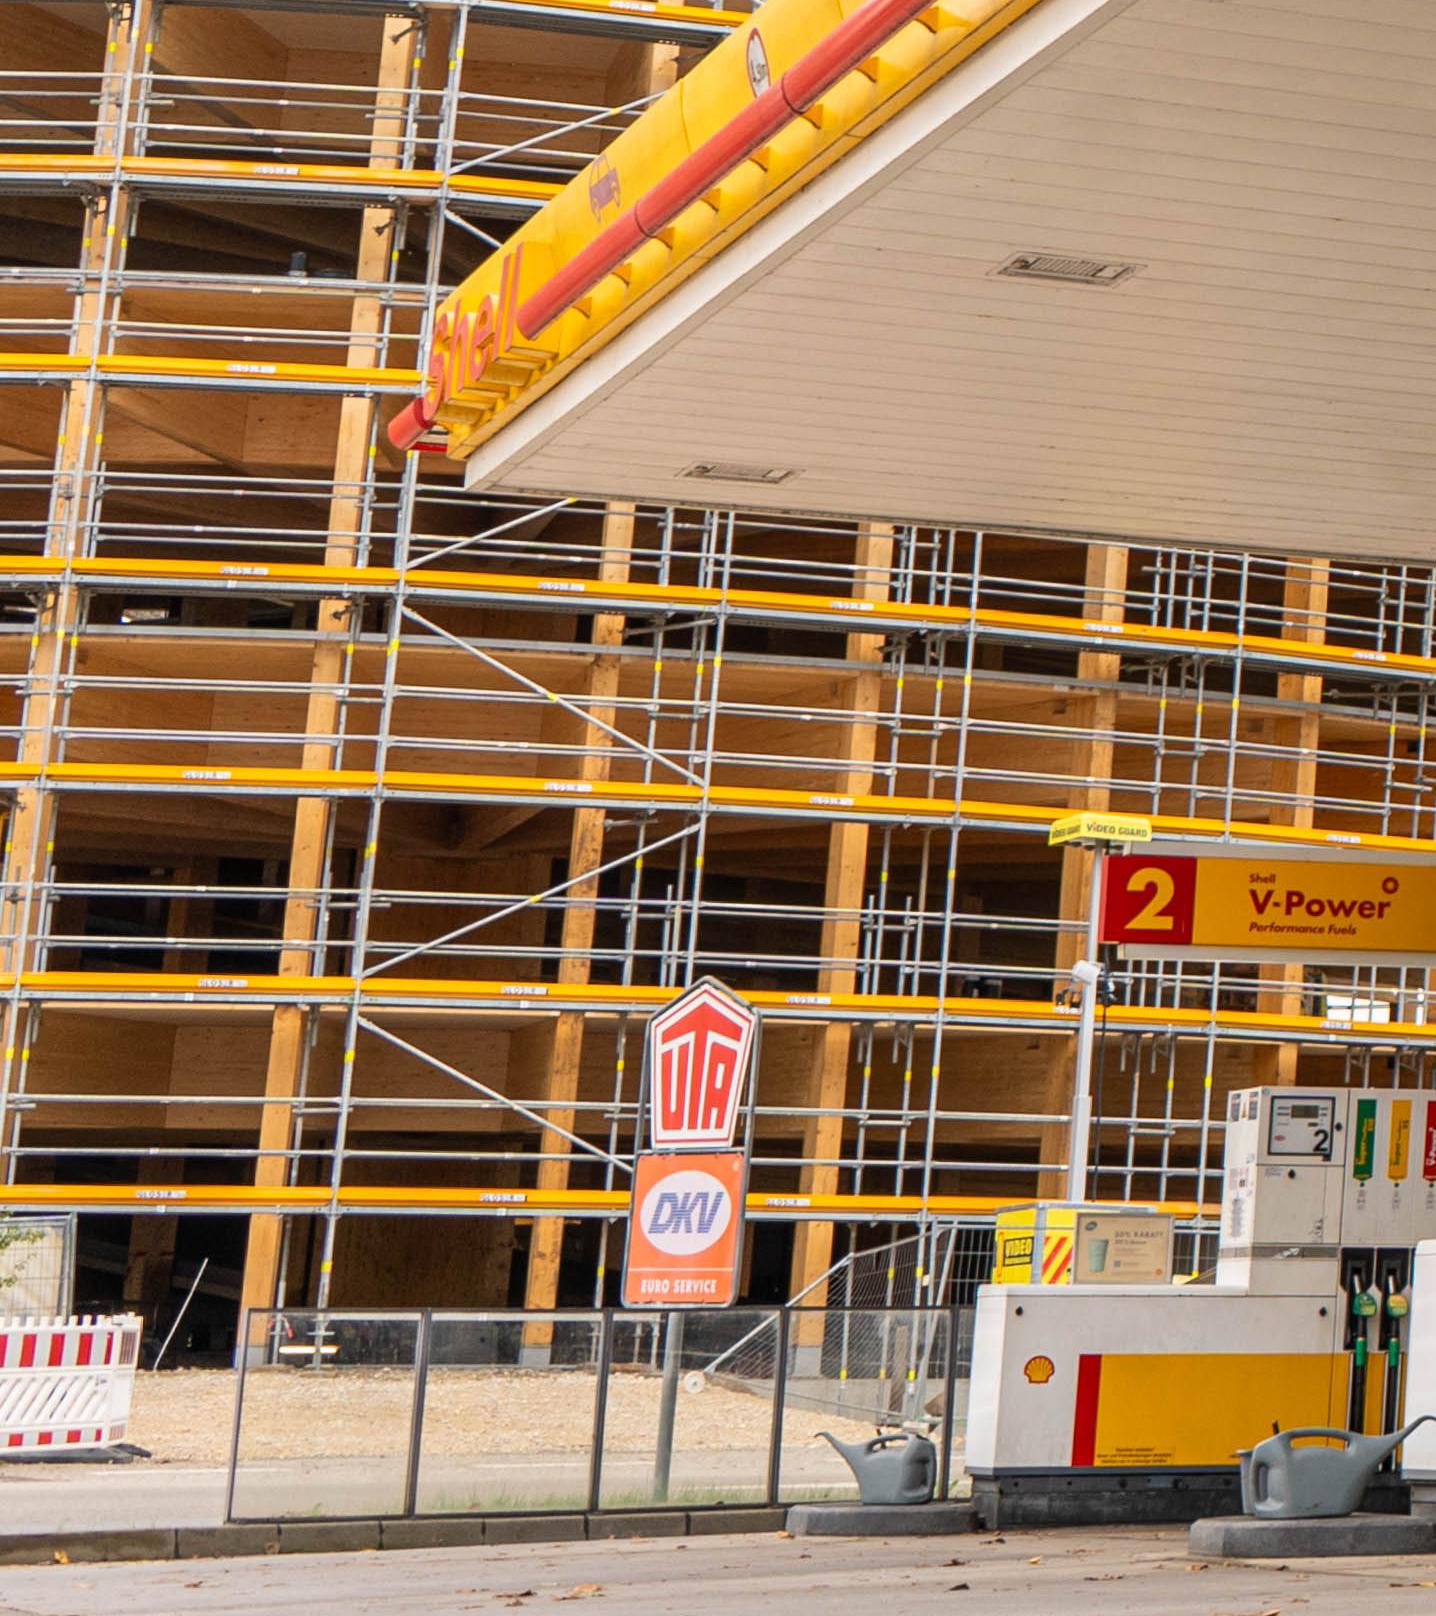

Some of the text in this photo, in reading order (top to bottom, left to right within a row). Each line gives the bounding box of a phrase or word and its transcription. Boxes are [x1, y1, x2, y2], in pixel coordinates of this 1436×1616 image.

[423, 244, 522, 422] Shell
[1248, 872, 1277, 885] Shell
[1124, 867, 1175, 930] 2
[1248, 890, 1392, 921] V-Power
[1248, 921, 1357, 936] Performance Fuels
[661, 1002, 744, 1131] UTA
[1313, 1129, 1330, 1152] 2
[648, 1191, 724, 1234] DKV
[1005, 1237, 1033, 1258] VIDEO
[640, 1279, 718, 1294] EURO SERVICE
